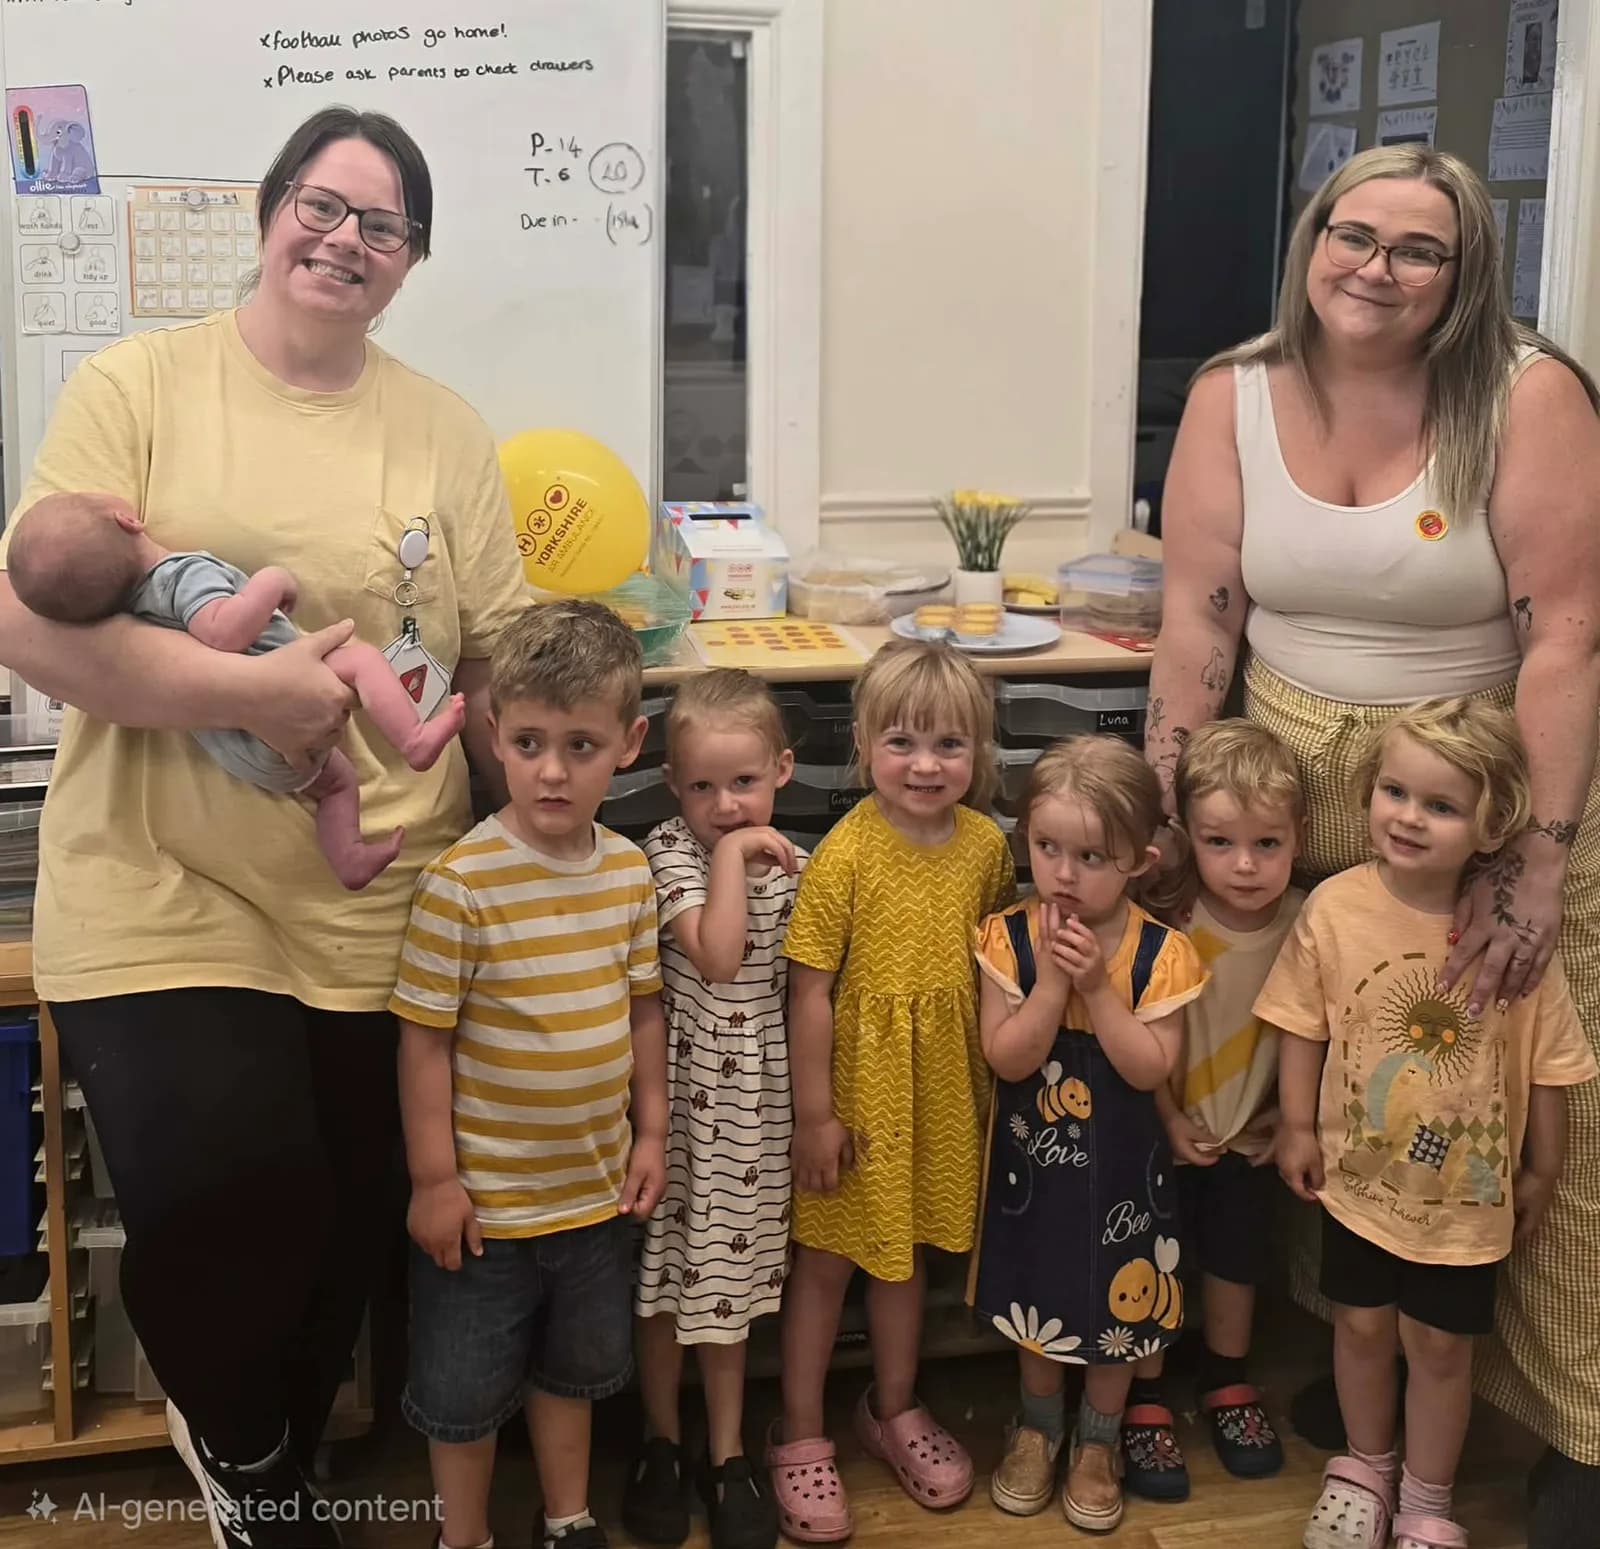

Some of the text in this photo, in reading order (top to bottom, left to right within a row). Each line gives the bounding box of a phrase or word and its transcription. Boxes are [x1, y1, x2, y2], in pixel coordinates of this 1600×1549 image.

[352, 26, 410, 48] photos
[423, 28, 447, 48] go
[454, 23, 507, 39] home!
[278, 65, 334, 86] Please
[346, 68, 376, 80] ask
[388, 66, 446, 80] parents
[454, 67, 470, 78] to
[476, 63, 519, 76] check
[530, 59, 594, 72] drawers
[521, 213, 547, 230] Due
[536, 498, 587, 567] YORKSHIRE
[1099, 713, 1129, 726] Luna
[1027, 1127, 1090, 1168] Love
[1102, 1201, 1151, 1245] Bee
